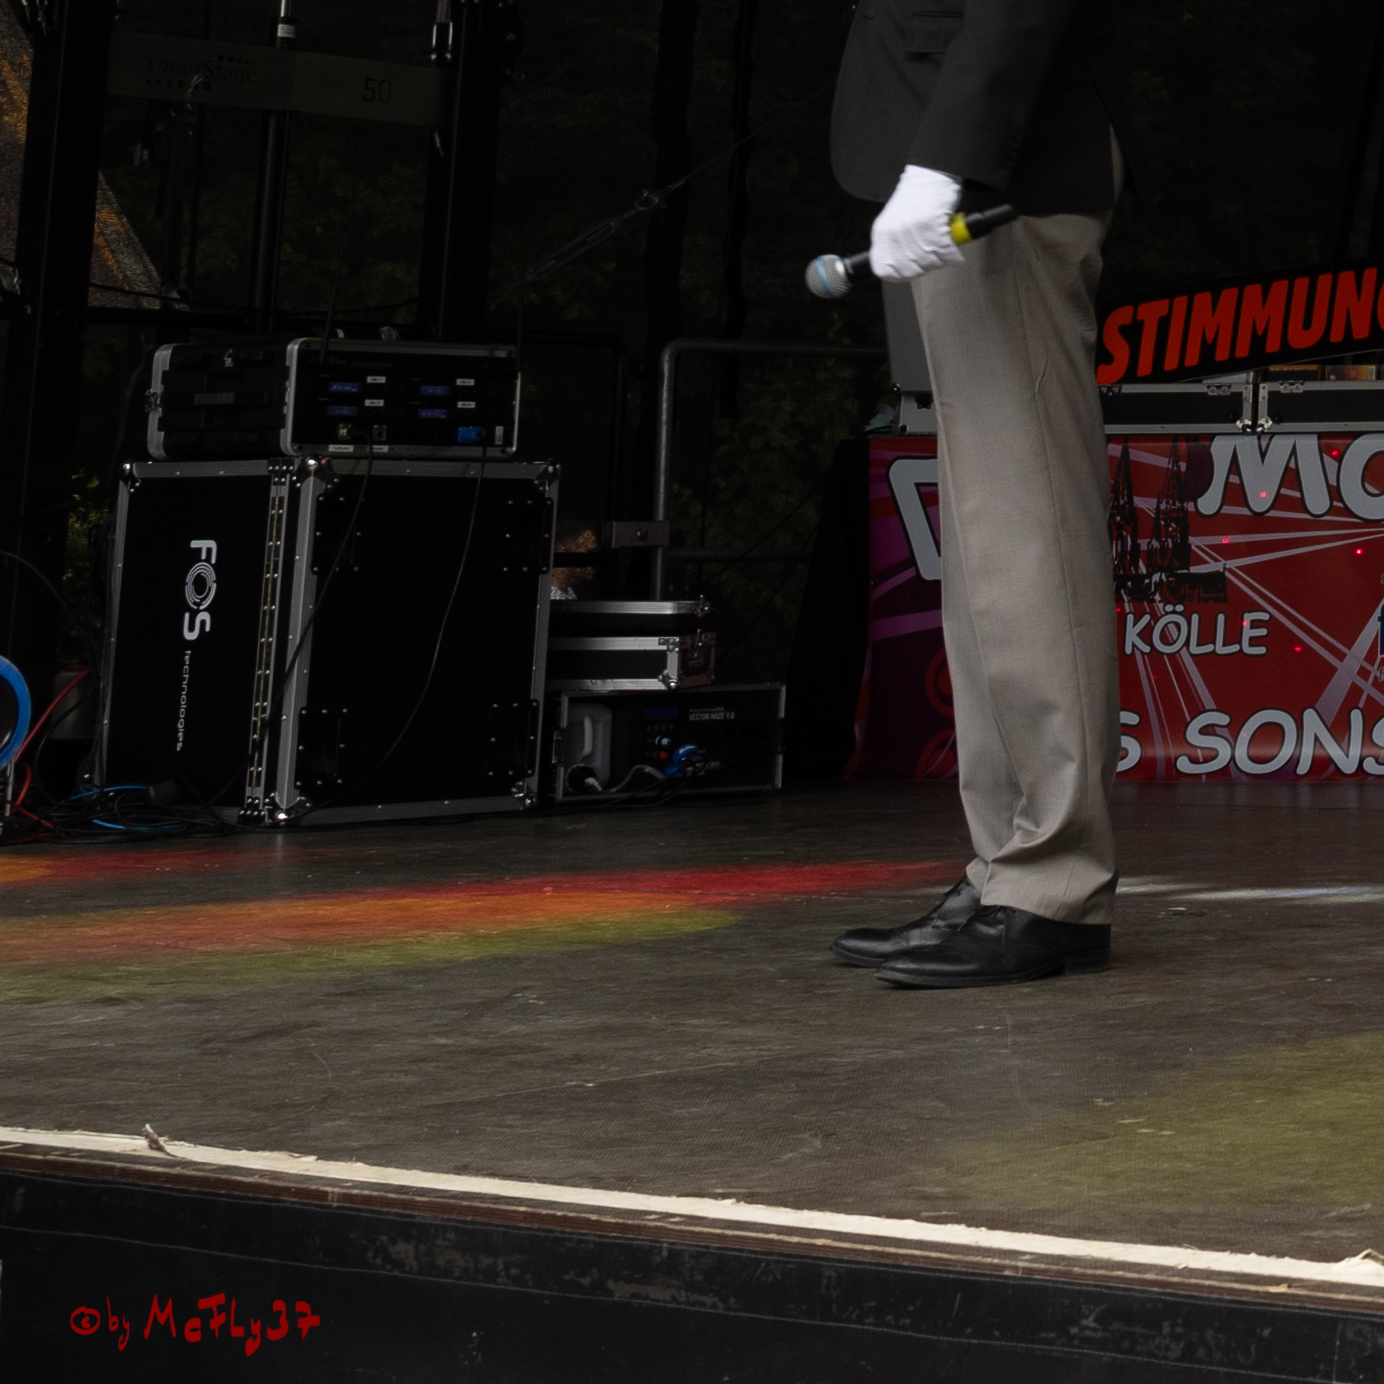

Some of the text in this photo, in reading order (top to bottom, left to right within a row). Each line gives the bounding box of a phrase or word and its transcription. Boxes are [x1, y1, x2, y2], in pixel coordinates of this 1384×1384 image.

[146, 58, 393, 104] smartStage 50
[176, 539, 218, 752] FOS technologies
[1124, 603, 1271, 656] KÖLLE
